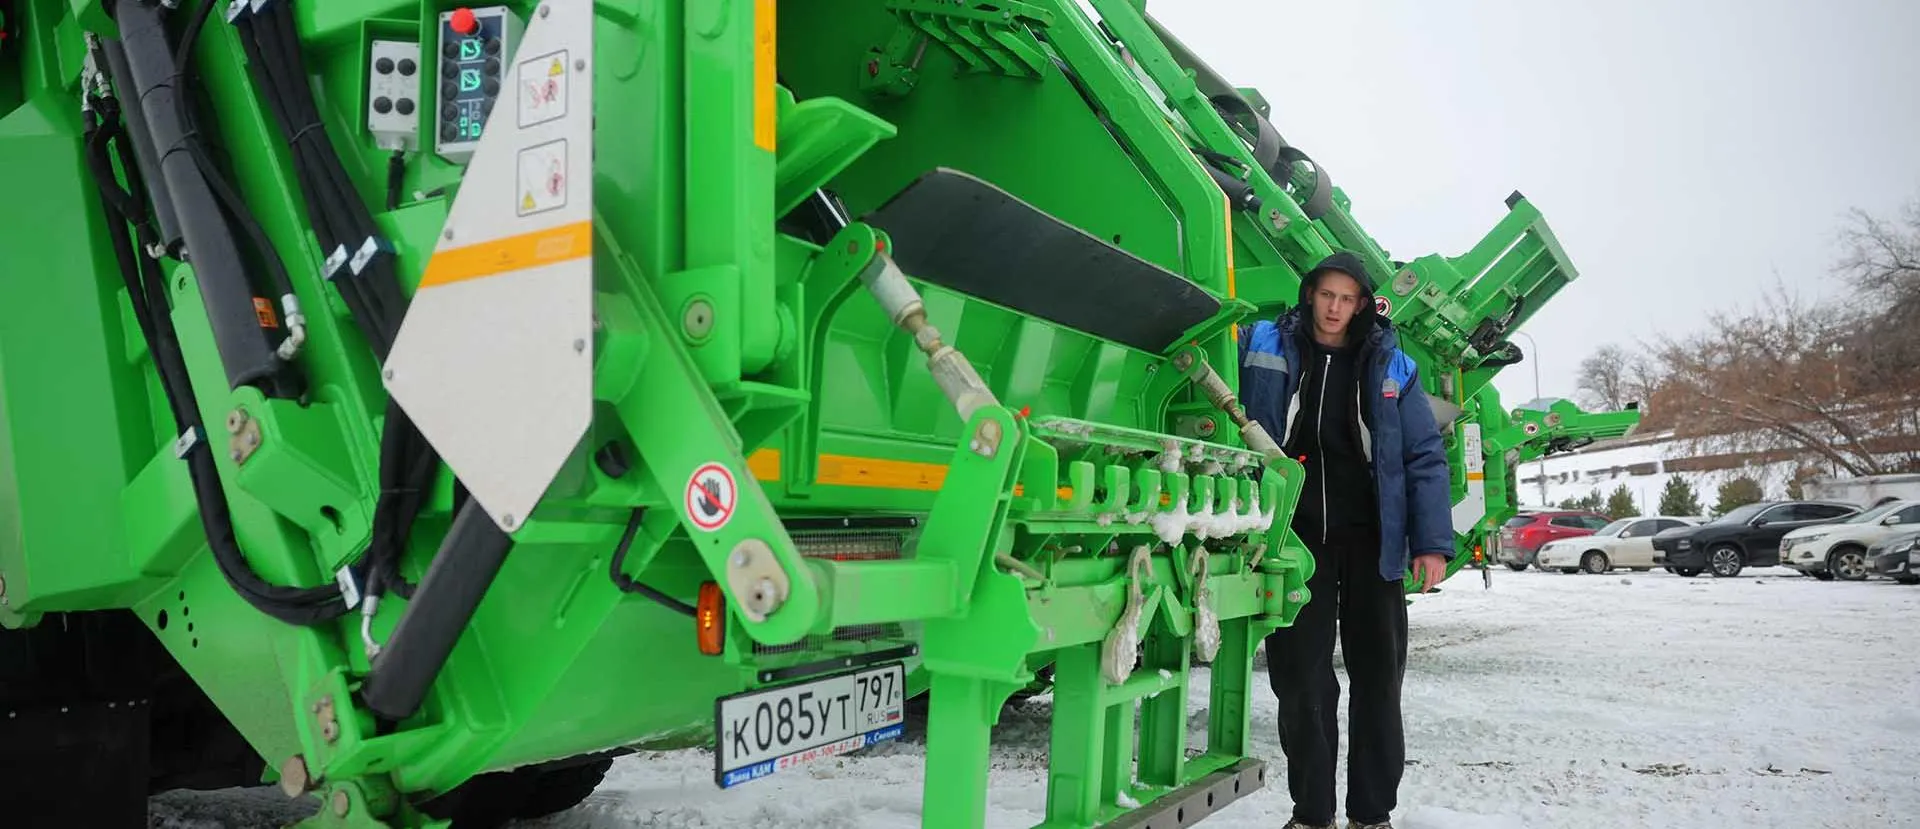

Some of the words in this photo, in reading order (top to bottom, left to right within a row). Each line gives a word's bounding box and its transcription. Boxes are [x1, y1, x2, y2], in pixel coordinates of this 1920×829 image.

[733, 691, 851, 759] К085УТ
[857, 672, 894, 712] 797
[867, 711, 886, 725] RUS
